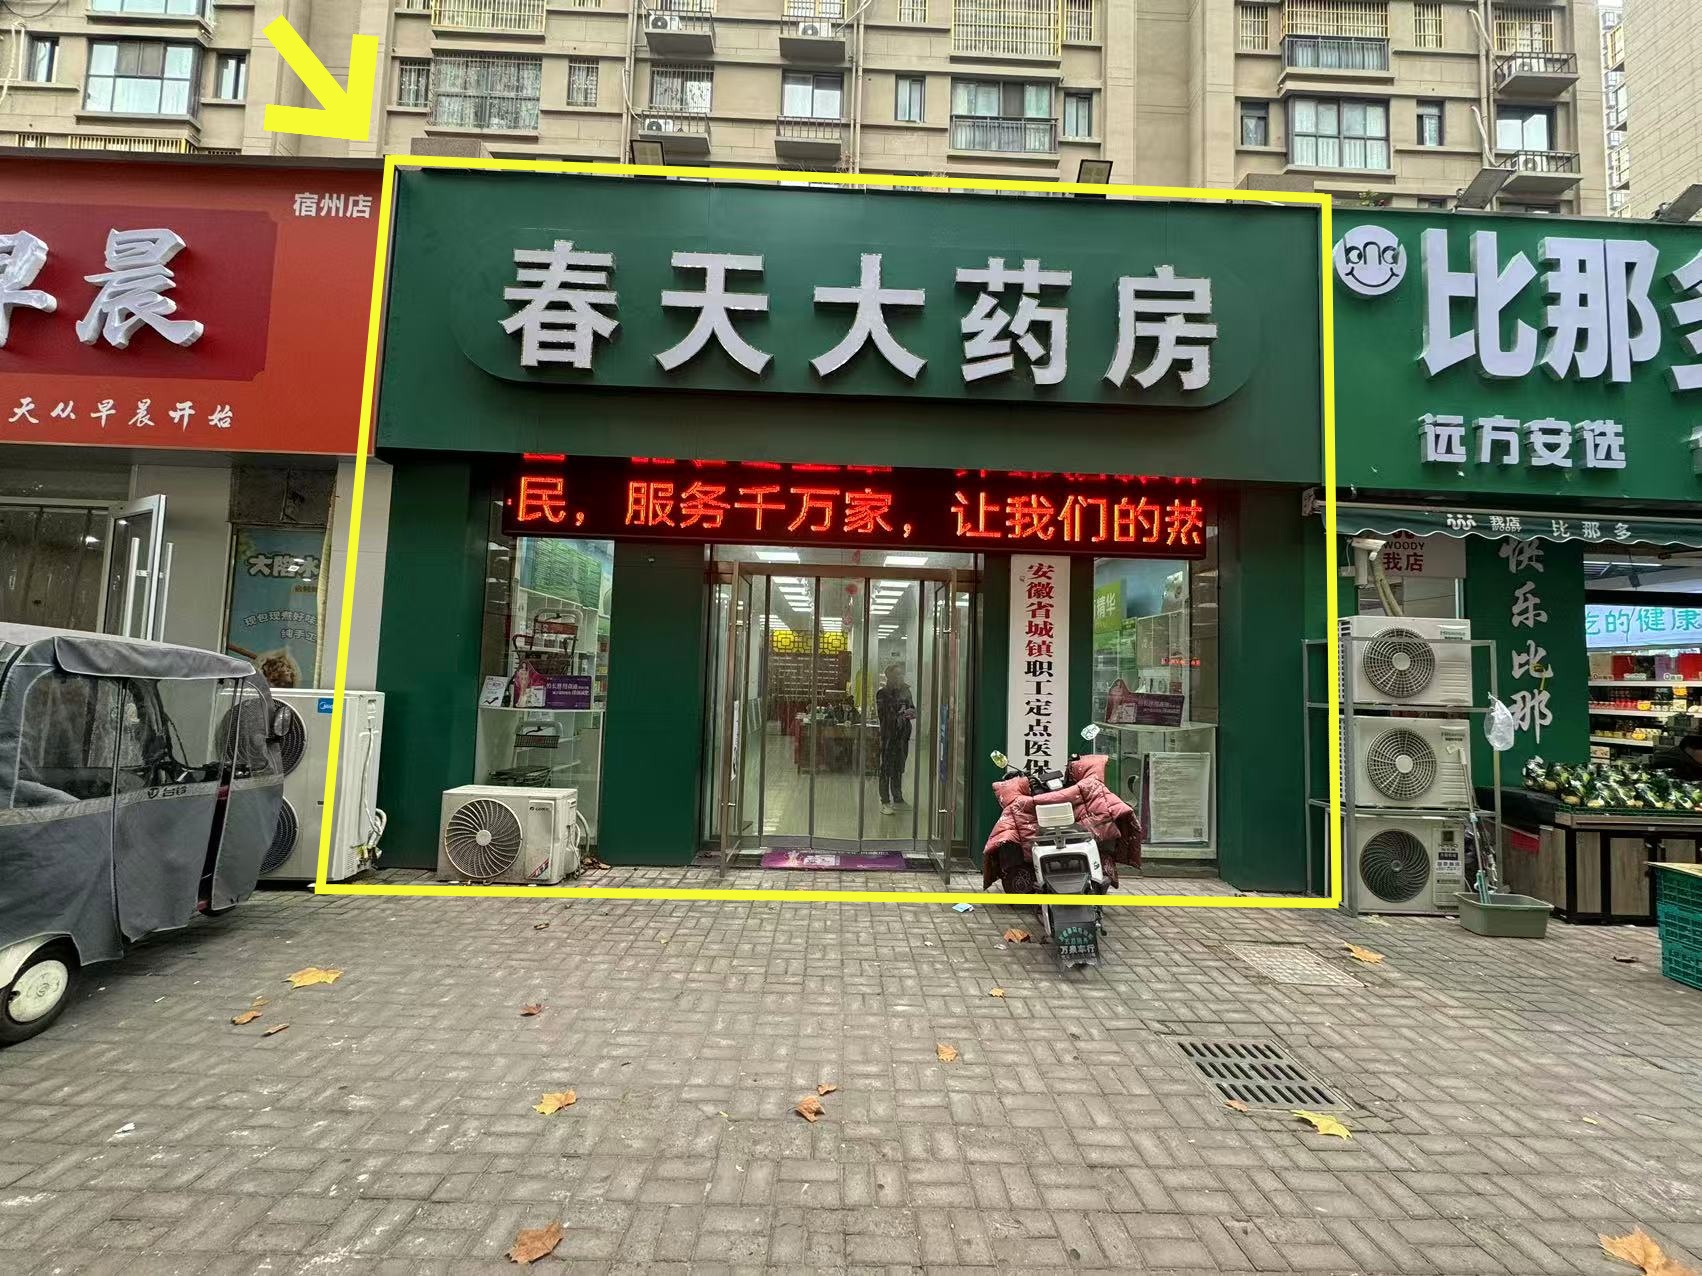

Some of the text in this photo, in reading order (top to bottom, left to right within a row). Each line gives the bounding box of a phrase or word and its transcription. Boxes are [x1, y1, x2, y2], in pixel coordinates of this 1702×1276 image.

[293, 193, 372, 219] 宿州店
[498, 239, 1219, 391] 春天大药房
[8, 397, 234, 432] 天从早晨开始
[1418, 413, 1627, 469] 远方安选
[1552, 520, 1632, 540] 比那多
[1384, 541, 1425, 550] WOODY
[1383, 552, 1423, 572] 我店
